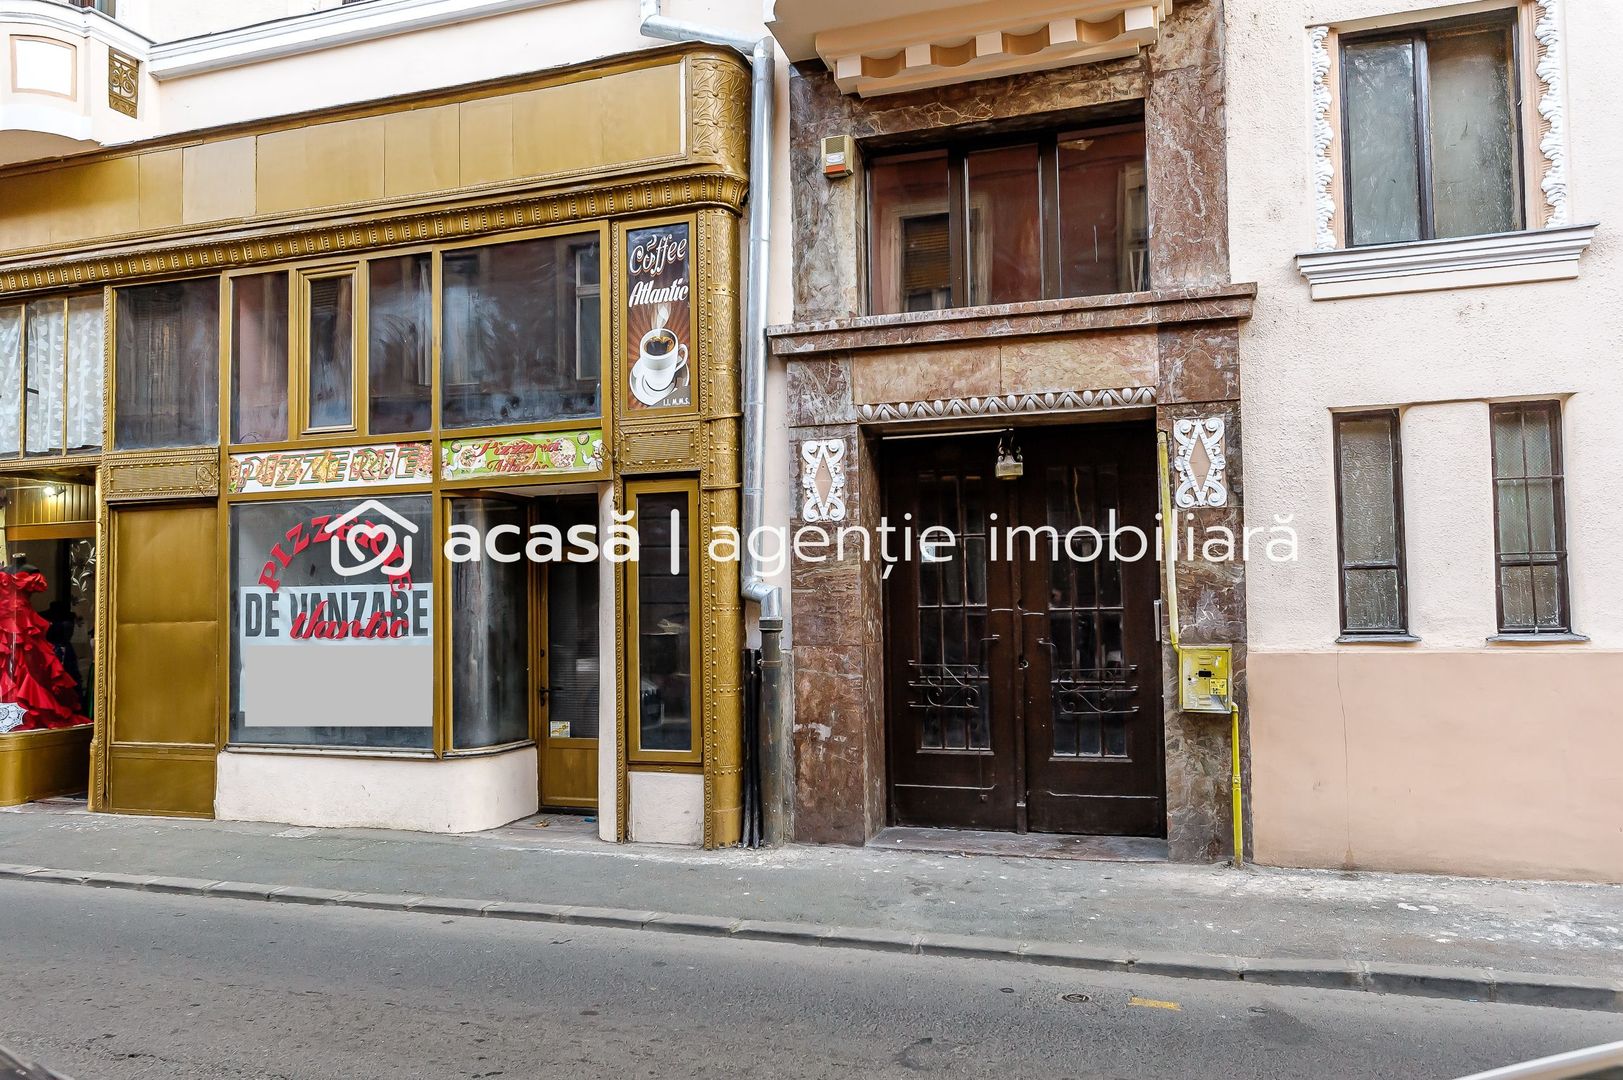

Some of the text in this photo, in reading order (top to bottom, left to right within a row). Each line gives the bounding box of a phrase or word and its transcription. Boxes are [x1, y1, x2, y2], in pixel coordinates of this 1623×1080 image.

[629, 233, 688, 277] Coffee
[628, 278, 689, 308] Atlantic
[237, 447, 420, 493] PIZZERIE
[245, 589, 429, 638] DE VANZARE
